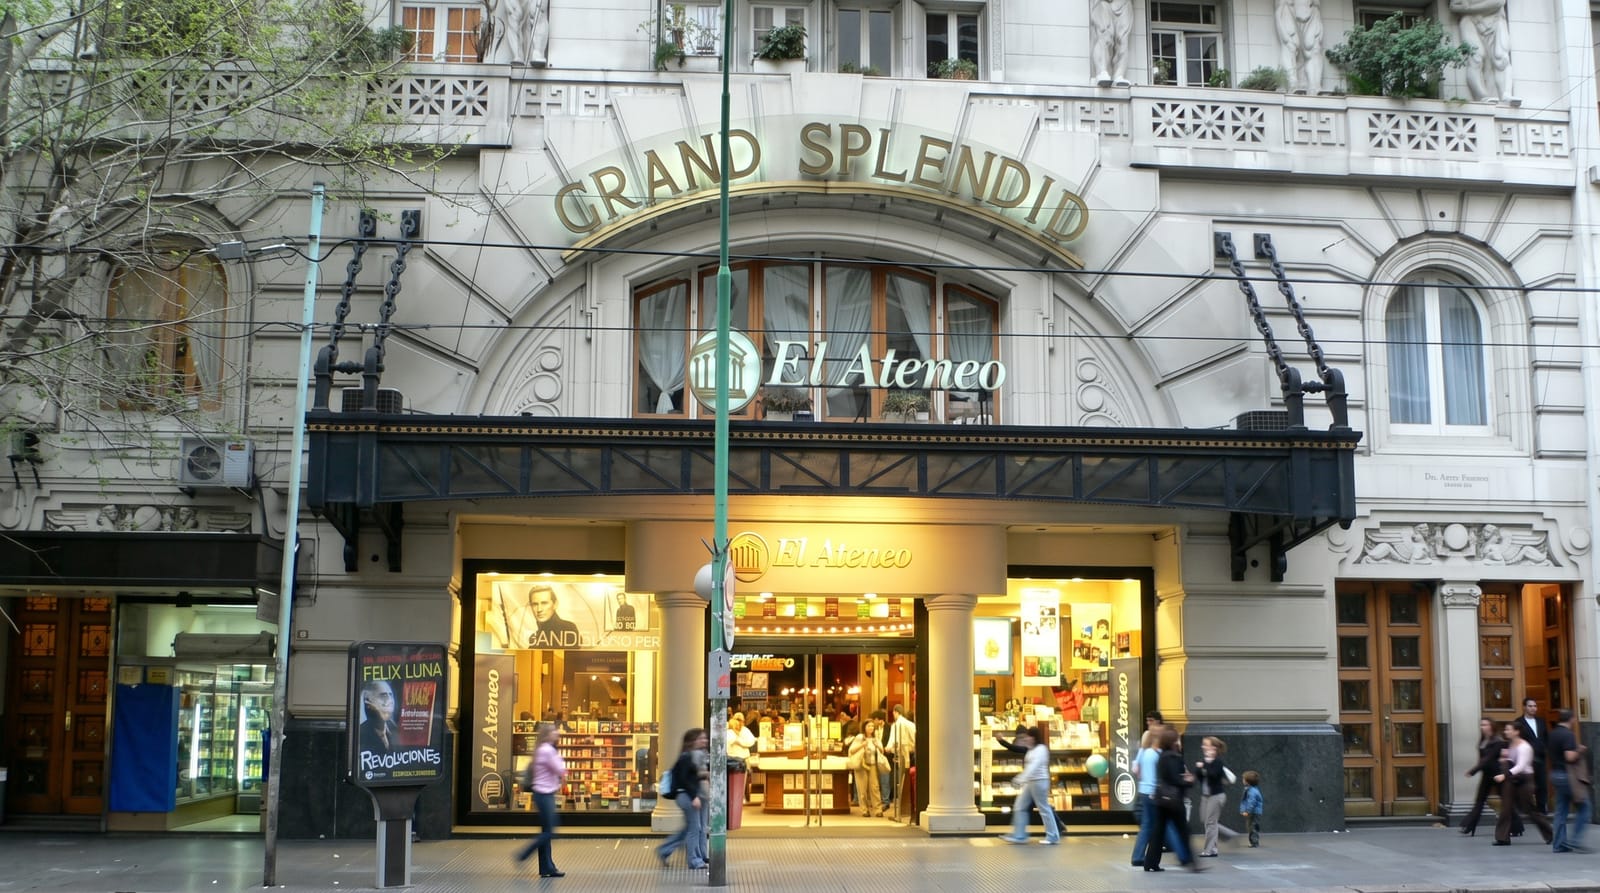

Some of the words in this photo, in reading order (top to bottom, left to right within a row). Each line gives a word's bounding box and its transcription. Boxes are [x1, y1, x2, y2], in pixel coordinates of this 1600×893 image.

[554, 128, 761, 234] GRAND
[799, 121, 1090, 242] SPLENDID
[764, 340, 827, 387] El
[837, 343, 1007, 391] Ateneo
[772, 537, 808, 567] El
[810, 538, 913, 568] Ateneo
[363, 664, 401, 682] FELIX
[405, 662, 443, 679] LUNA
[482, 669, 500, 743] Ateneo
[1116, 672, 1130, 746] Ateneo
[360, 748, 441, 771] REVOLUCIONES
[482, 745, 498, 772] El
[1116, 747, 1130, 772] El
